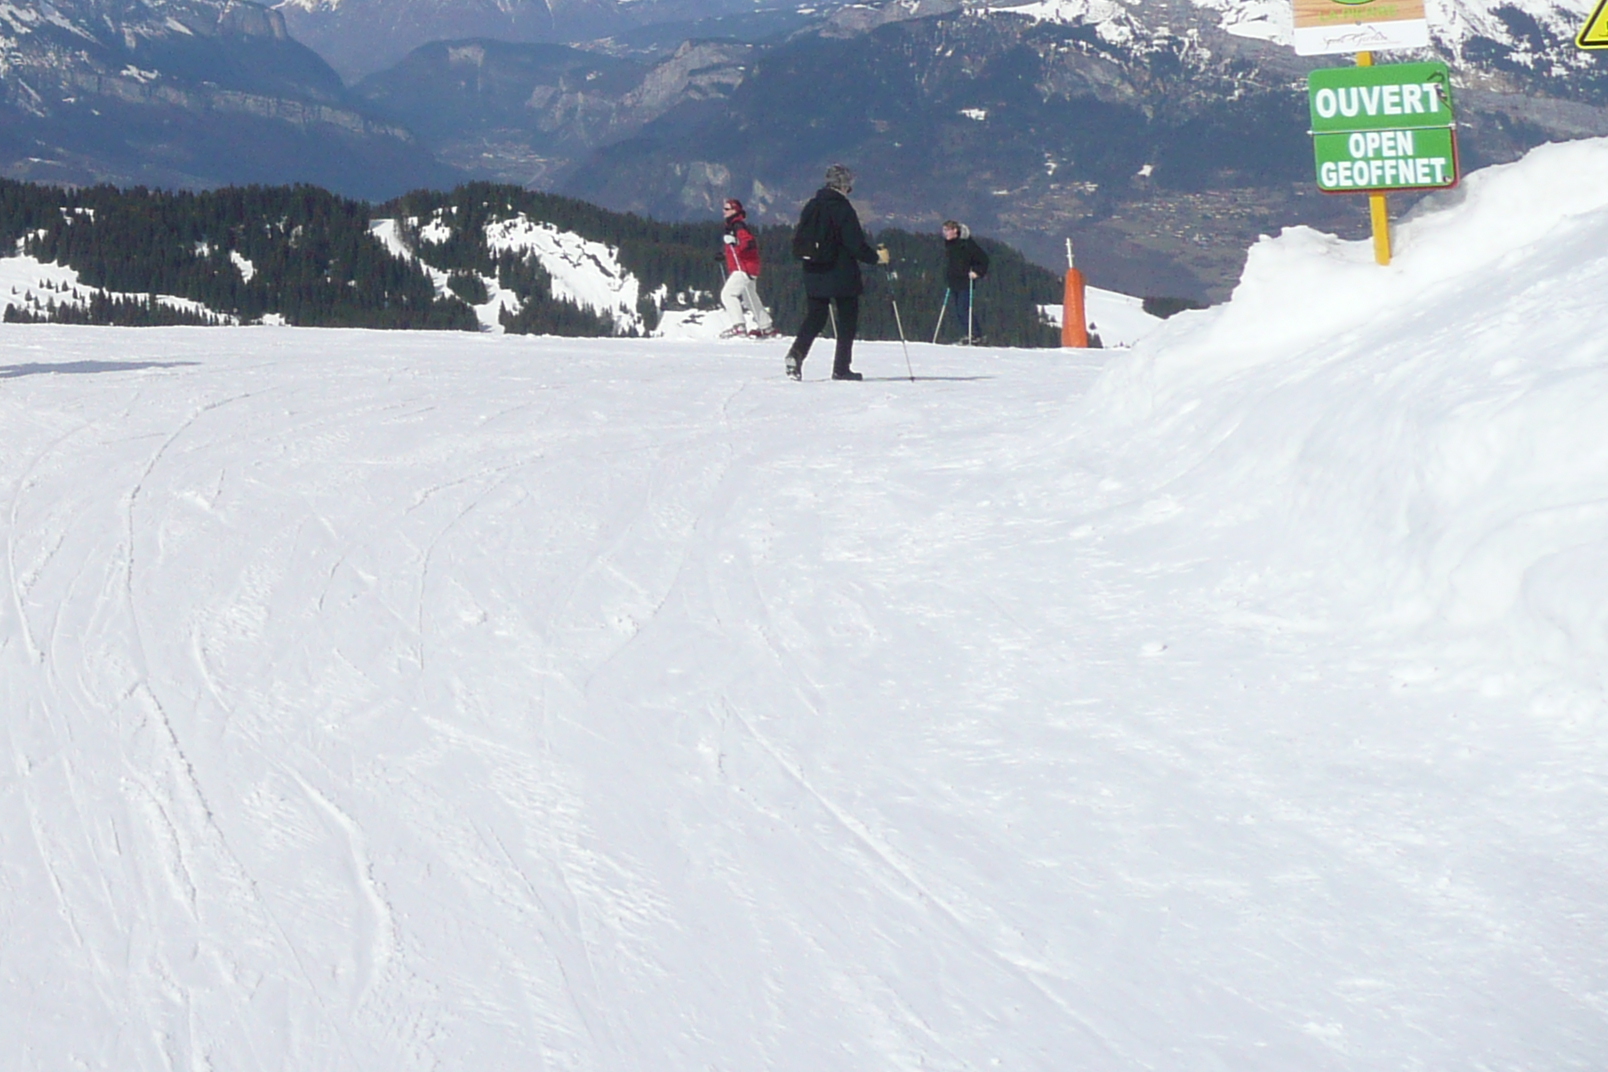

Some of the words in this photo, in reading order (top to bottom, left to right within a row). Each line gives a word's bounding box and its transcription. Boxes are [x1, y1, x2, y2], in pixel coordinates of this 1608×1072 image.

[1320, 9, 1339, 21] LA
[1343, 4, 1398, 19] PIERRE
[1315, 82, 1442, 119] OUVERT
[1349, 130, 1415, 159] OPEN
[1321, 157, 1447, 188] GEOFFNET
